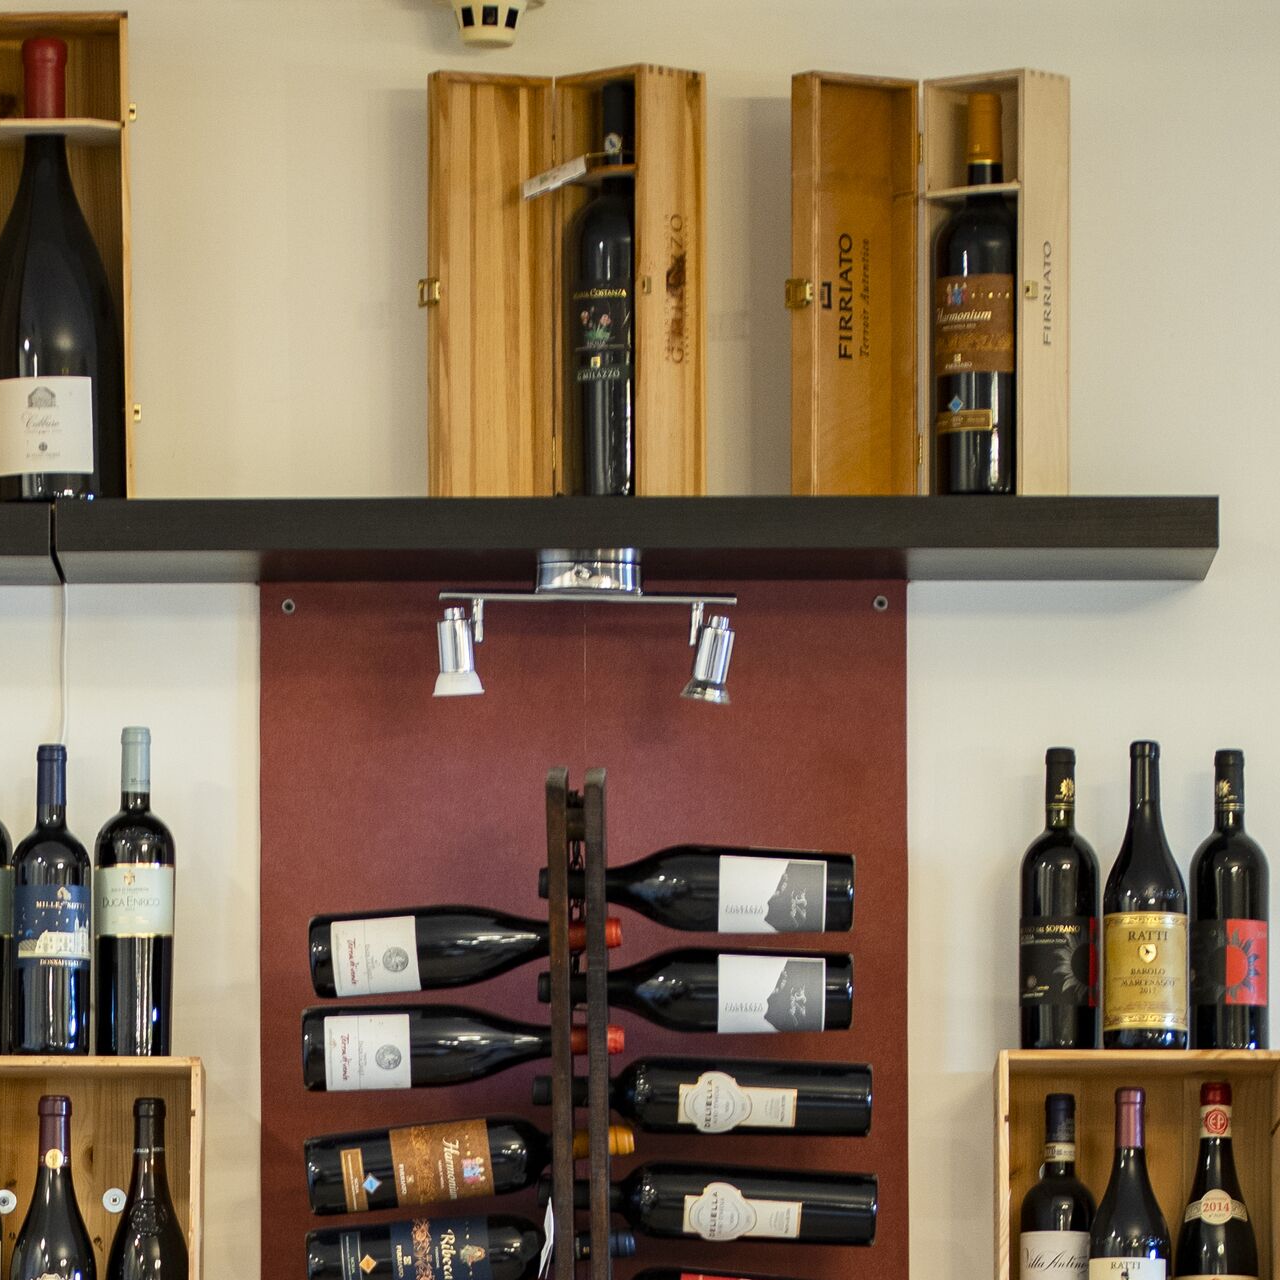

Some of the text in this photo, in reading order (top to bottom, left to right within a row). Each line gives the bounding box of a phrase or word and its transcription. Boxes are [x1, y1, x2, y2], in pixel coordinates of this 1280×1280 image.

[838, 233, 853, 360] FIRRIATO
[860, 238, 870, 357] Terroir Autentico
[1043, 240, 1053, 345] FIRRIATO
[101, 896, 161, 907] DUCA ENRICO
[1045, 924, 1080, 933] SOPRANO
[1128, 930, 1169, 942] RATTI
[1130, 967, 1166, 975] BAROLO
[442, 1136, 460, 1200] Harmonium
[1203, 1201, 1230, 1212] 2014
[439, 1228, 457, 1280] Ribeca
[1110, 1260, 1141, 1270] RATTI
